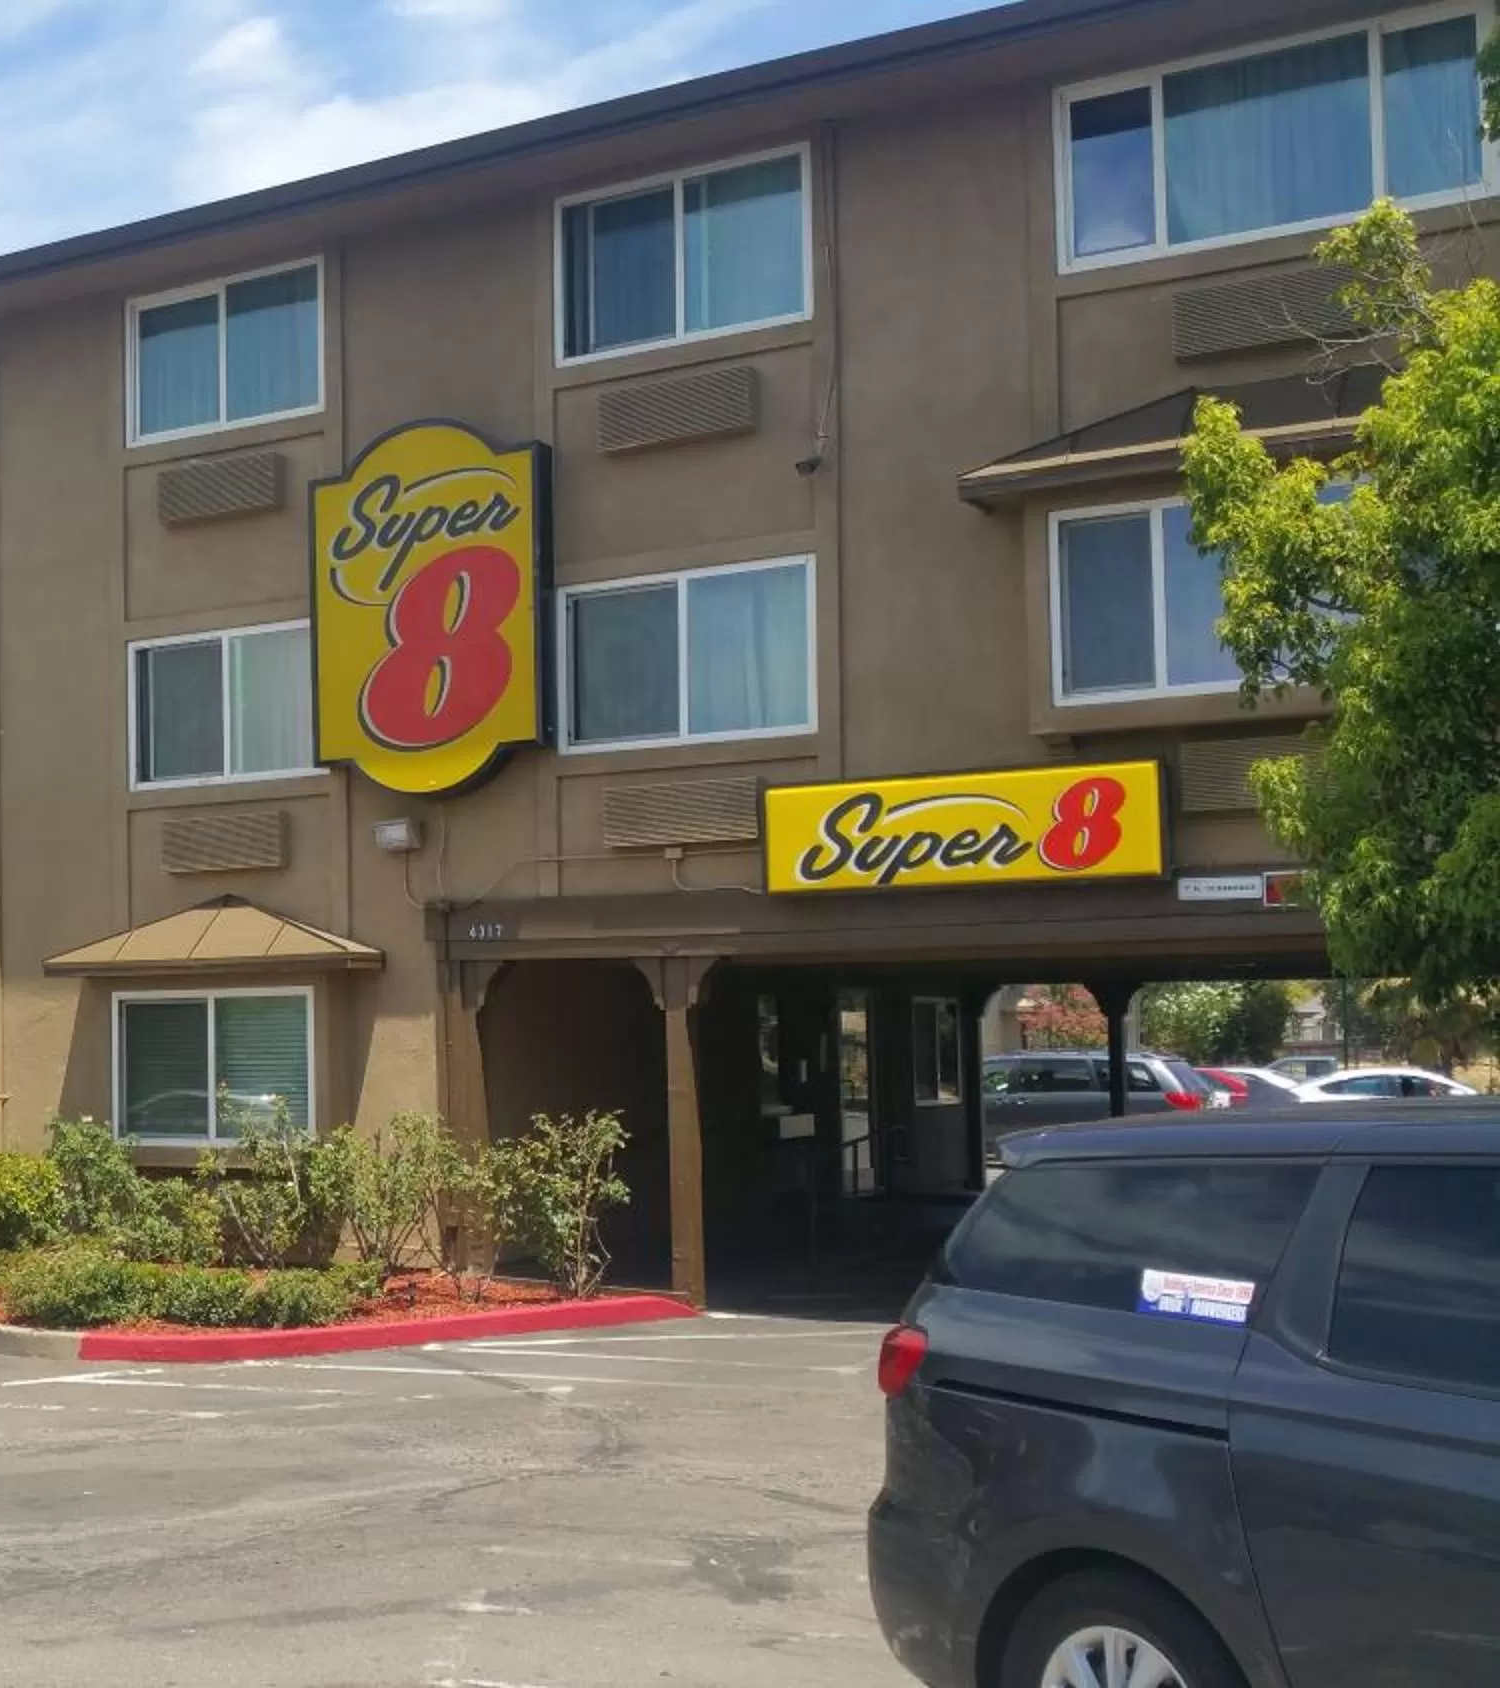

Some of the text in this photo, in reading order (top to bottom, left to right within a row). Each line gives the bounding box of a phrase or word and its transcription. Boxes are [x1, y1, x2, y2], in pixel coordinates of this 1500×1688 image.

[332, 475, 522, 592] Super
[358, 544, 521, 753] 8
[796, 776, 1126, 884] Super 8
